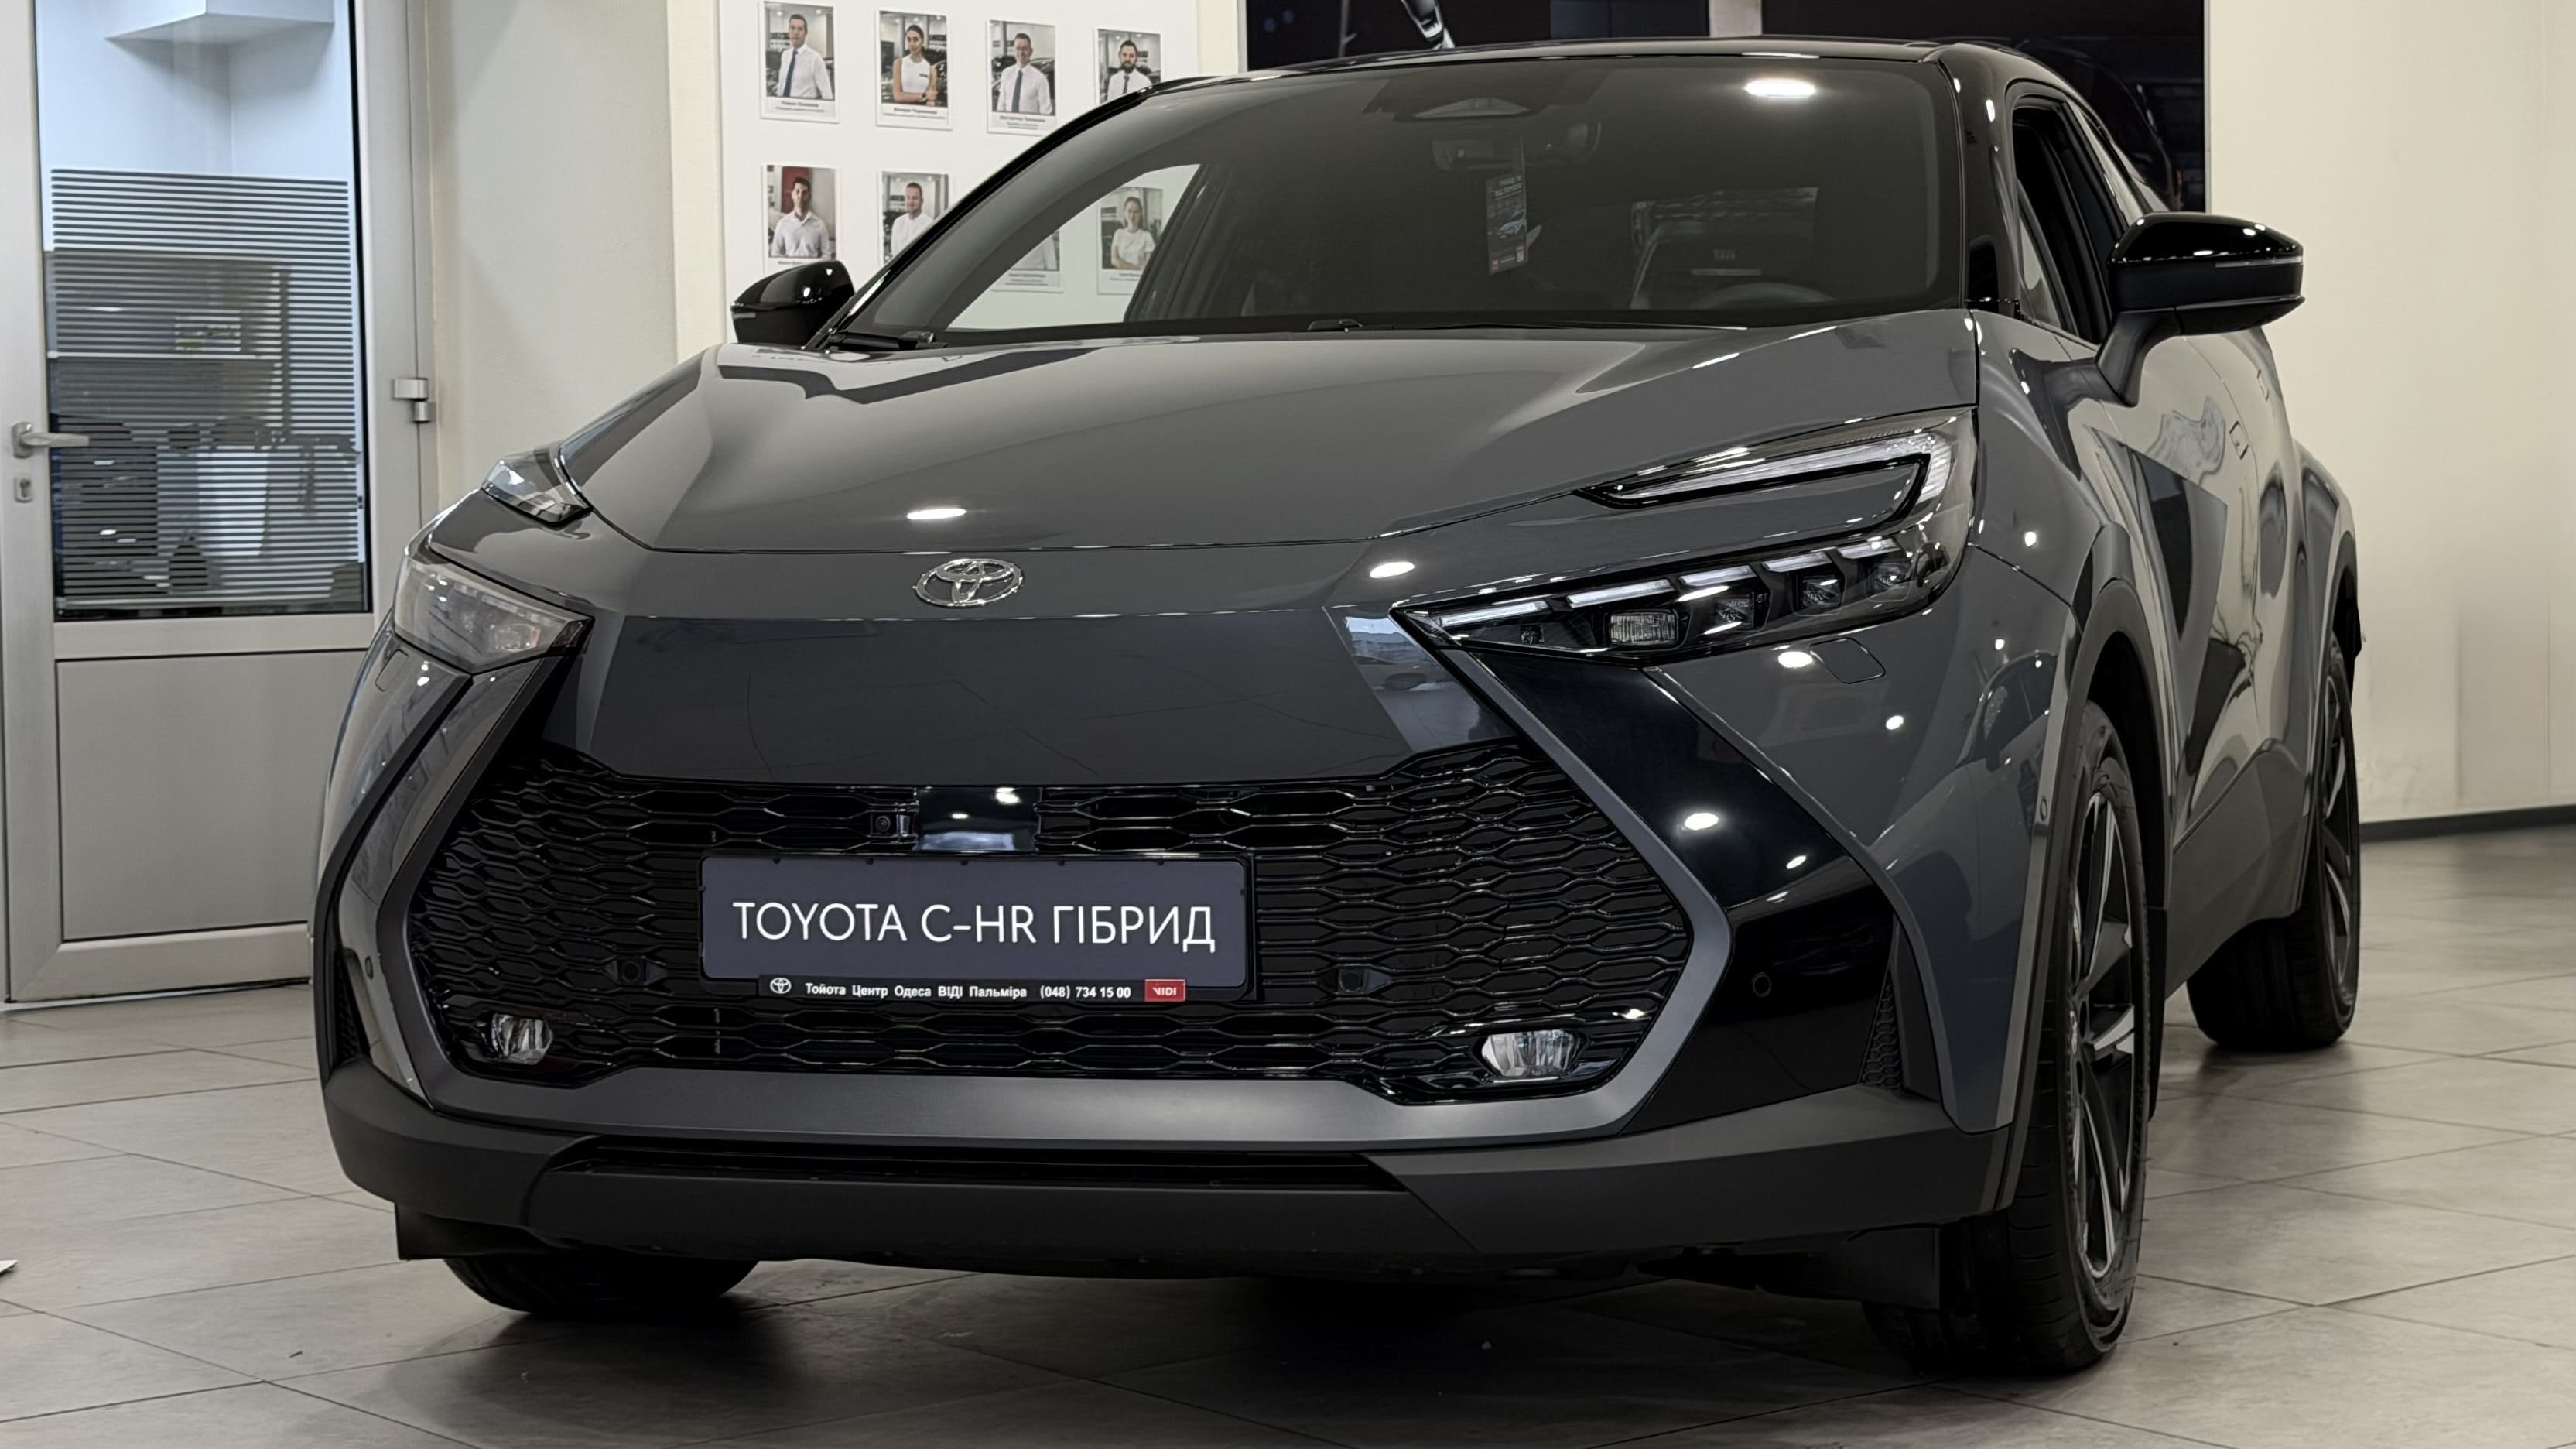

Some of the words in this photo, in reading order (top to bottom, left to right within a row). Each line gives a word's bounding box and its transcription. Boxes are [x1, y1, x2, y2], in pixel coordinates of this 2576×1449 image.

[732, 902, 908, 942] TOYOTA
[921, 904, 1037, 944] C-HR
[1053, 905, 1216, 954] ГІБРИД
[805, 982, 847, 996] Тойота
[851, 984, 889, 999] Центр
[894, 985, 932, 999] Одеса
[937, 985, 963, 999] ВІДІ
[969, 985, 1028, 1000] Пальміра
[1040, 984, 1071, 999] (048)
[1075, 985, 1097, 999] 734
[1099, 985, 1114, 999] 15
[1116, 986, 1131, 999] 00
[1152, 987, 1177, 996] VIDI
